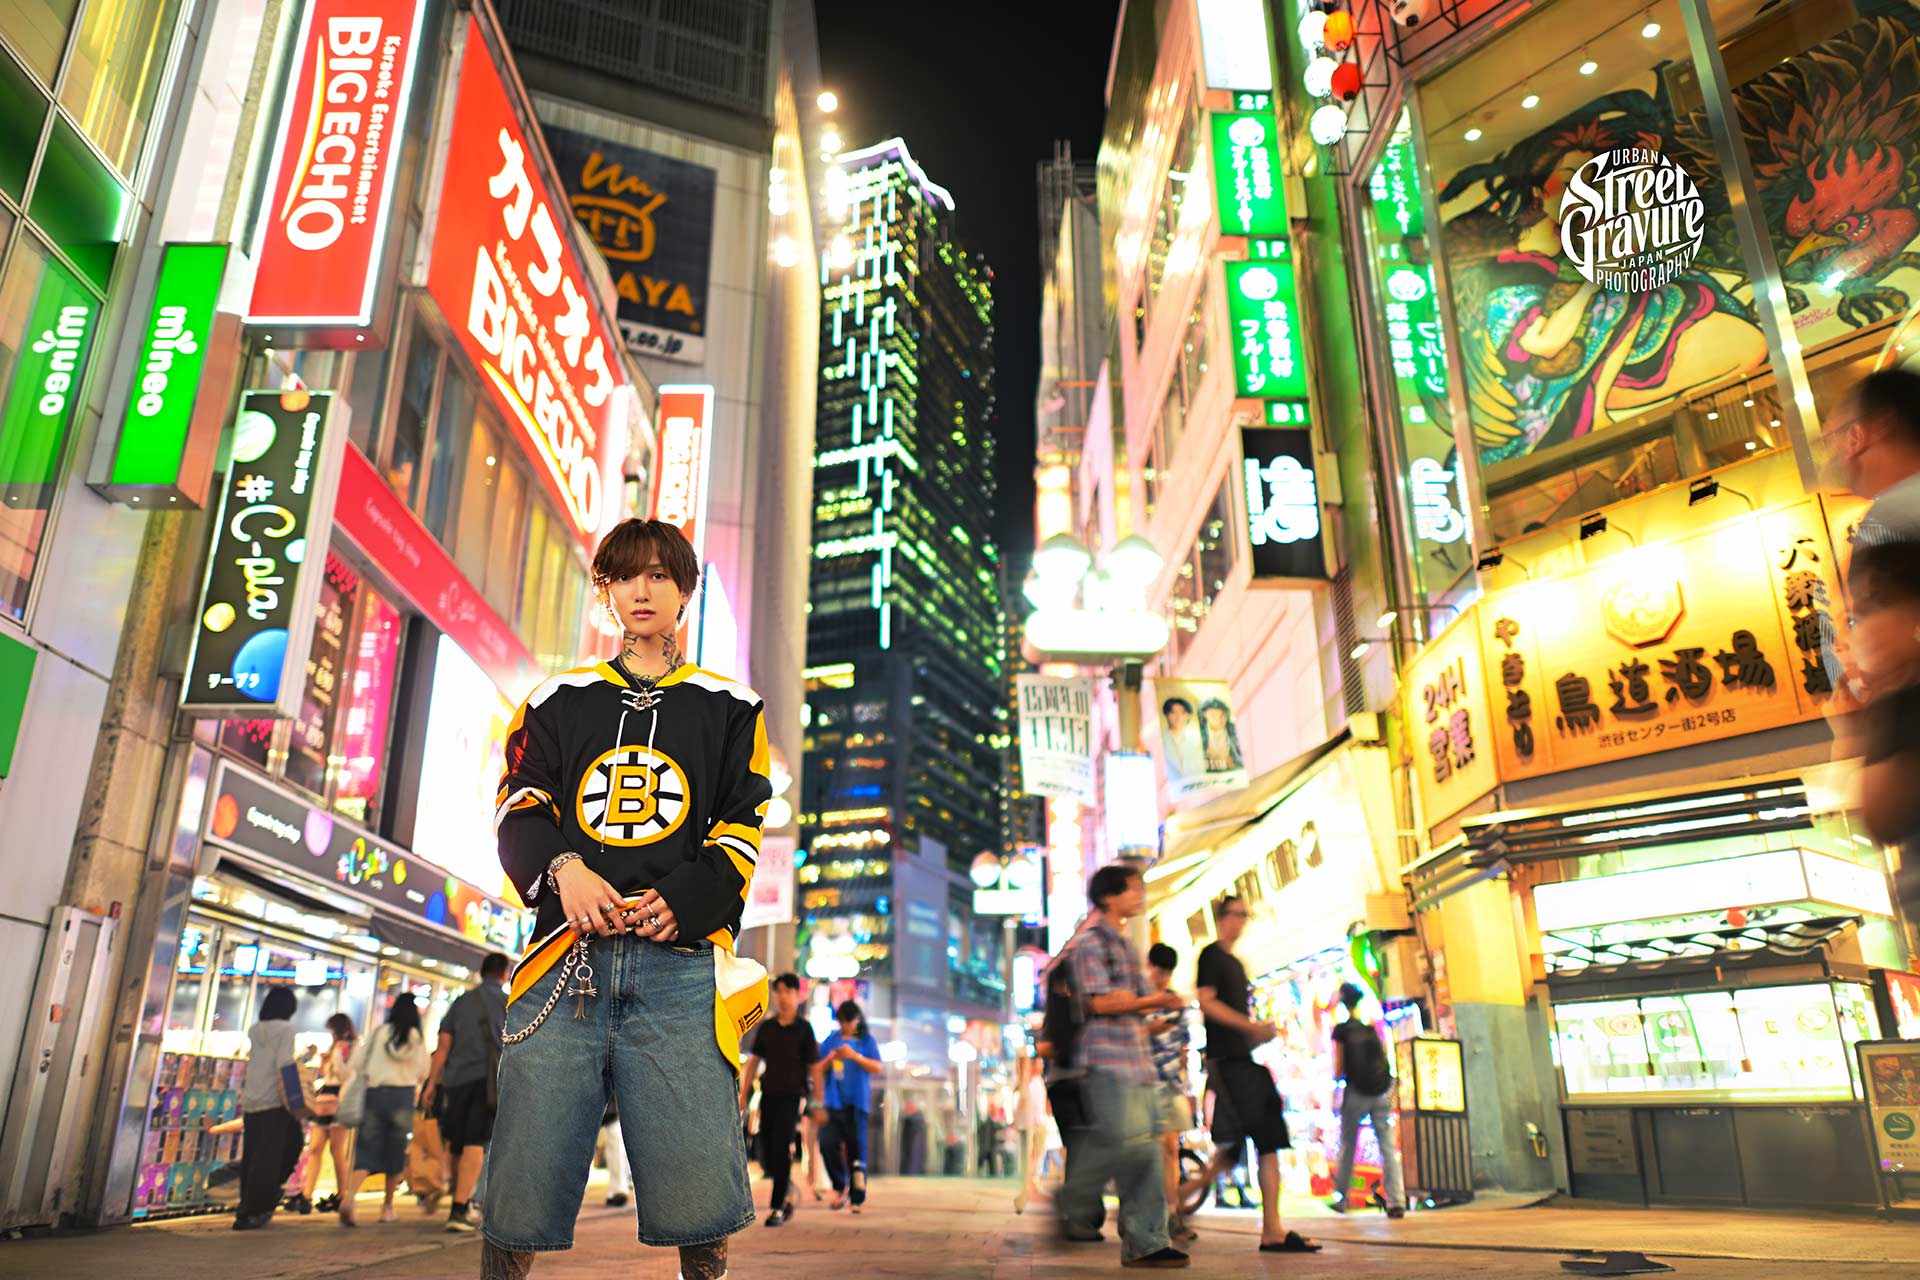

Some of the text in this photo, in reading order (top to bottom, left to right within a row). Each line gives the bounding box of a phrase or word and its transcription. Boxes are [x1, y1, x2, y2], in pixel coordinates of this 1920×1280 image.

[287, 17, 383, 250] BIG ECHO
[351, 35, 401, 224] Karaoke Entertainment
[1240, 95, 1268, 109] 2F
[488, 127, 615, 407] カラオケ
[1256, 241, 1286, 258] 1F
[138, 307, 198, 417] mineo
[468, 246, 602, 533] BIG ECHO
[1239, 319, 1266, 392] フルーツ
[1272, 403, 1305, 423] B1
[1424, 656, 1467, 724] 24H
[1555, 629, 1777, 733] 鳥道酒場
[1429, 708, 1475, 784] 営業
[1599, 707, 1737, 749] 渋谷センター街2号店
[605, 765, 662, 825] B
